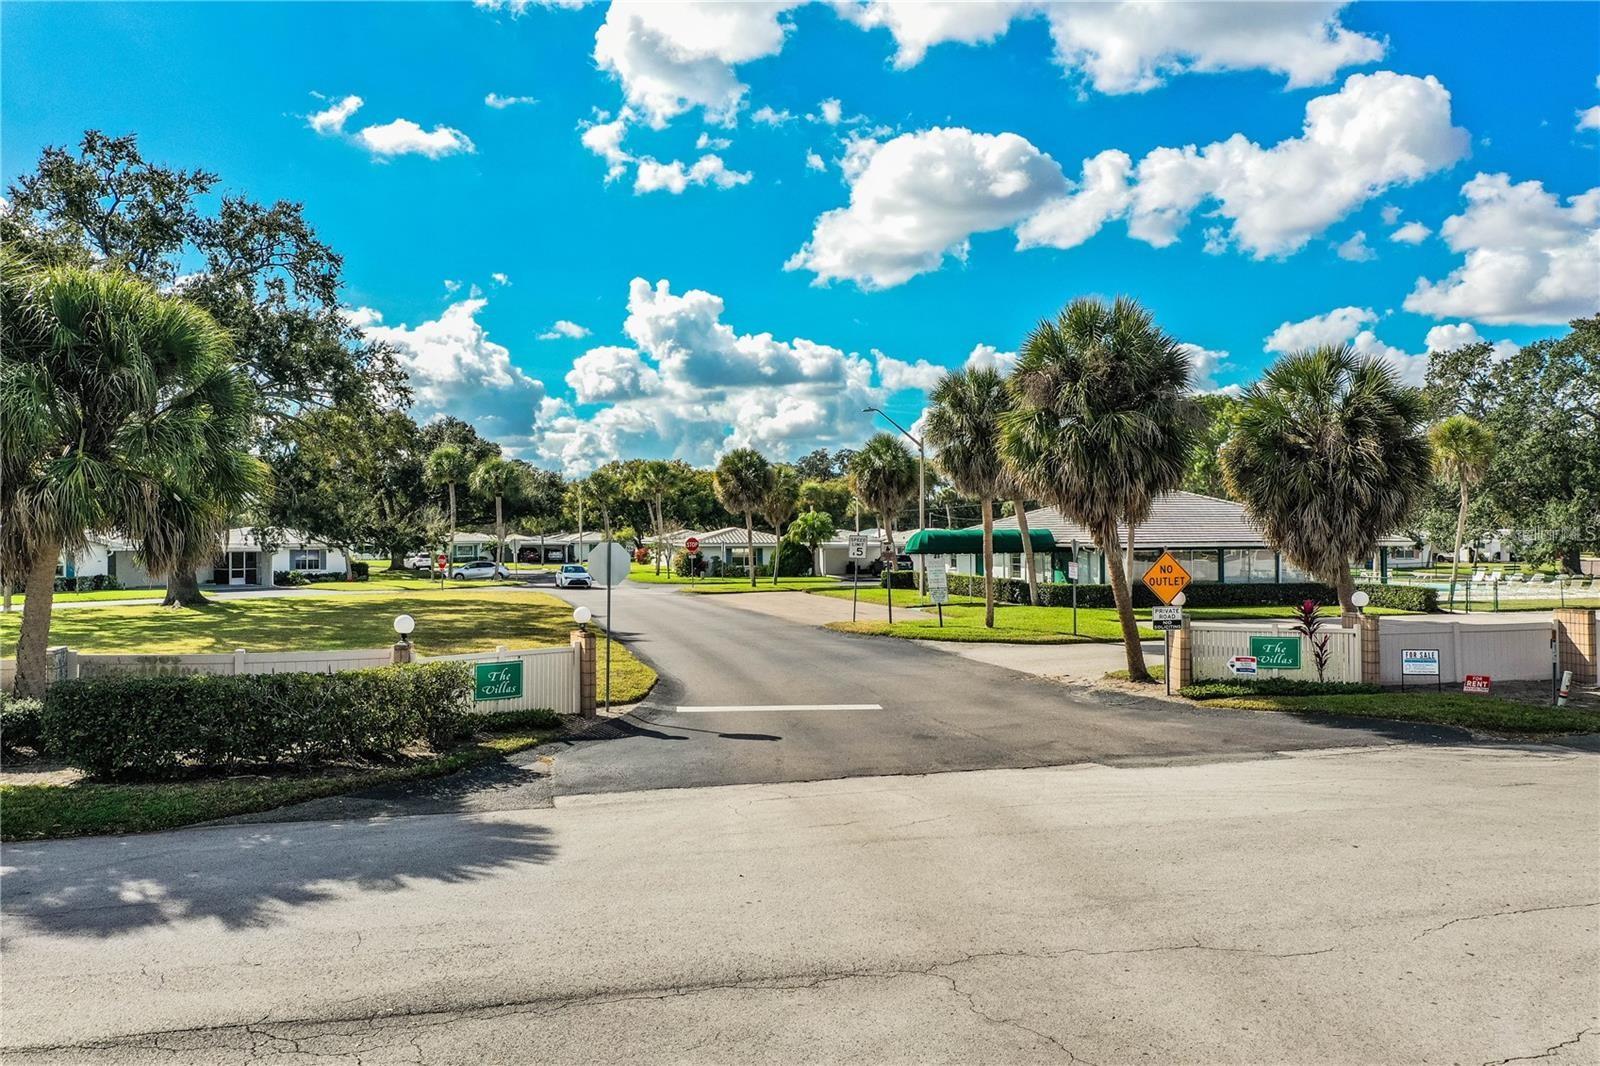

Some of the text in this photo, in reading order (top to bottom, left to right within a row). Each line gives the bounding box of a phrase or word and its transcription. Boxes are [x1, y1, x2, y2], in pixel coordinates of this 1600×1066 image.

[1160, 565, 1173, 574] NO
[1149, 576, 1185, 587] OUTLET
[1262, 641, 1287, 653] The
[1257, 652, 1294, 665] Villas
[1419, 651, 1435, 659] SALE
[487, 667, 511, 681] The
[481, 680, 517, 695] Villas
[1466, 680, 1488, 688] RENT
